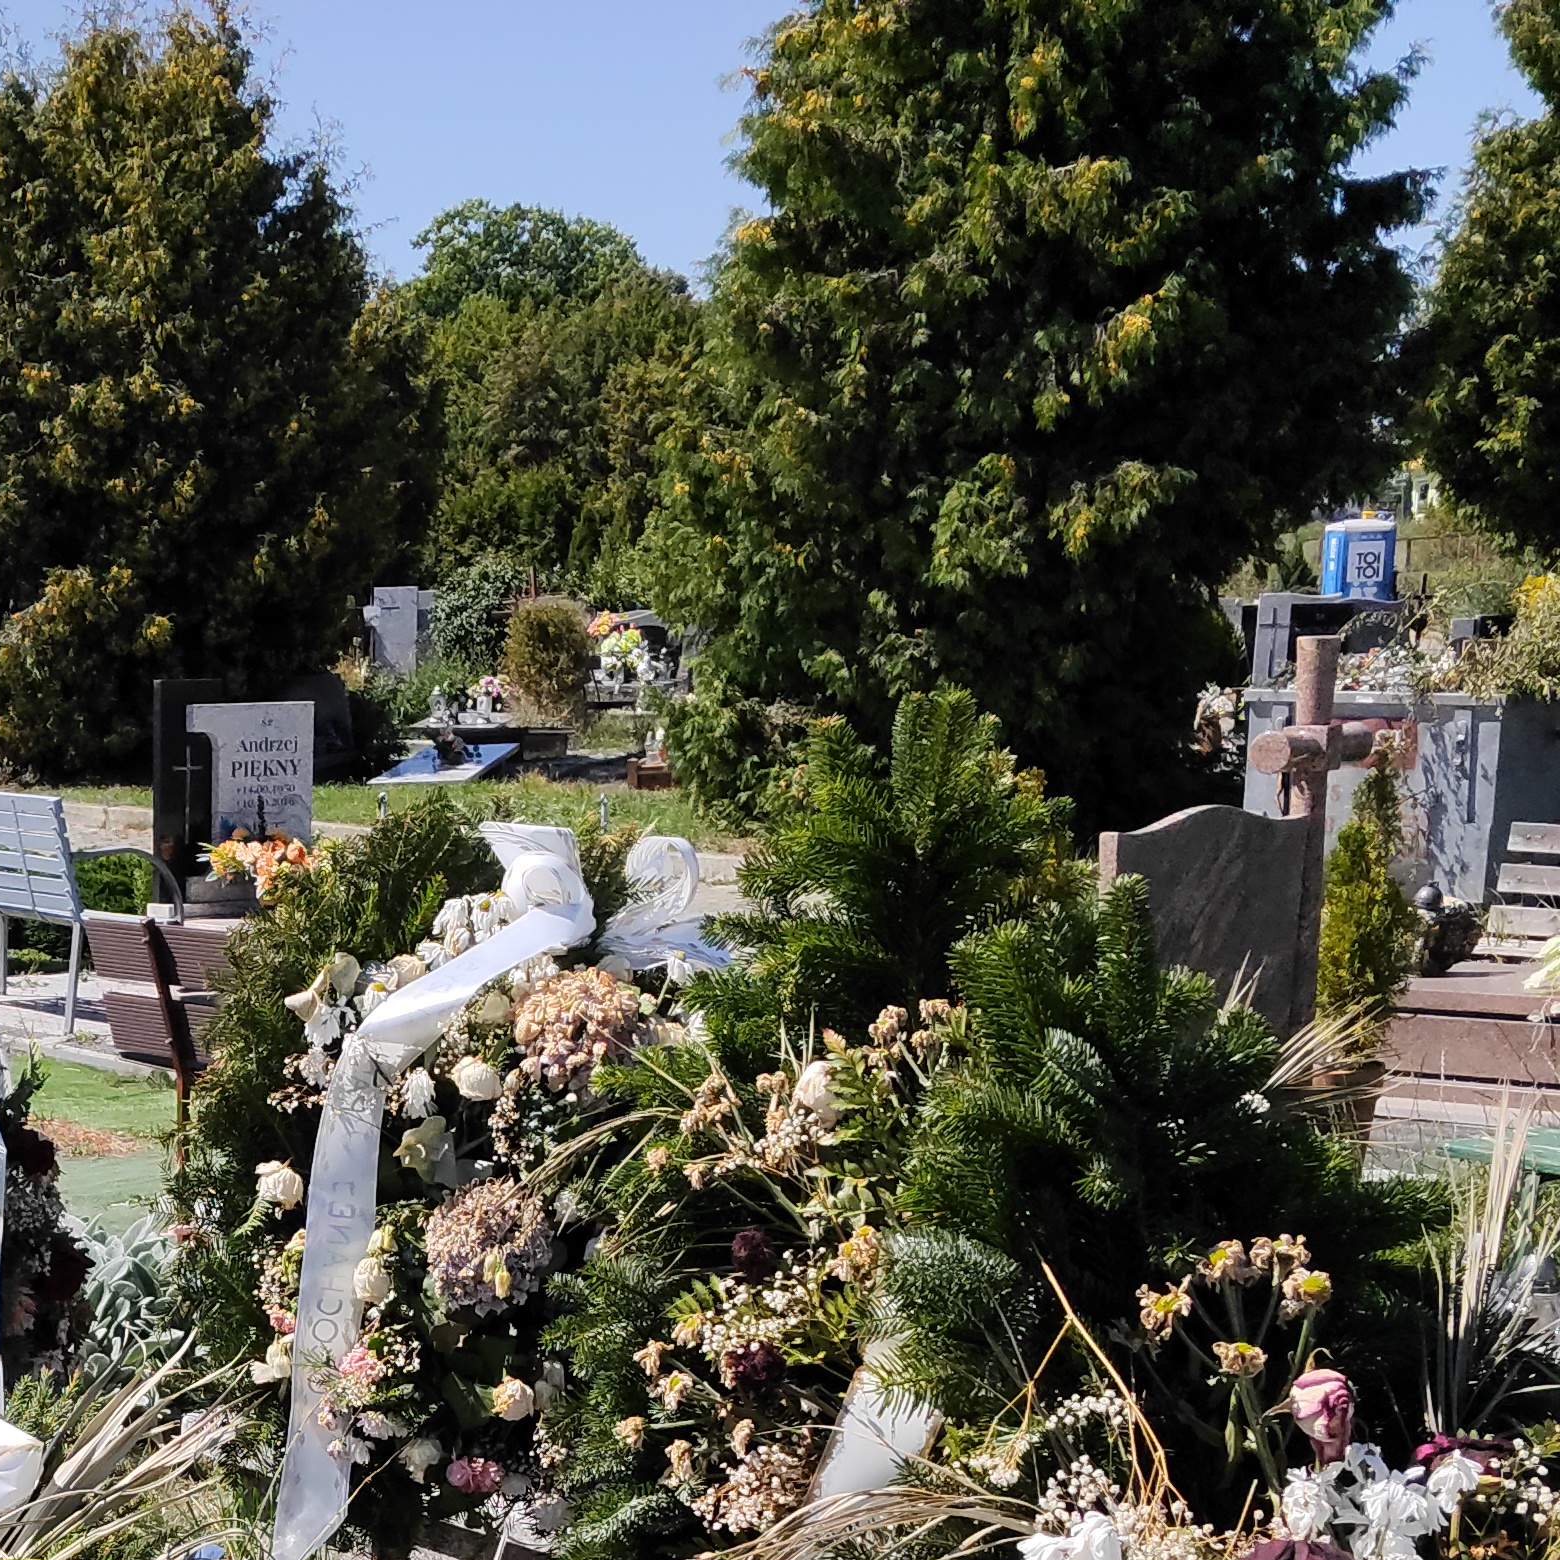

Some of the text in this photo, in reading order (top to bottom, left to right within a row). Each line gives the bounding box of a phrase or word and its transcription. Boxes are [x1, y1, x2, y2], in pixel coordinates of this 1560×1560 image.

[1356, 551, 1381, 565] TOI
[1355, 565, 1380, 579] TOI
[236, 736, 298, 753] Andrzej
[231, 759, 301, 782] PIĘKNY
